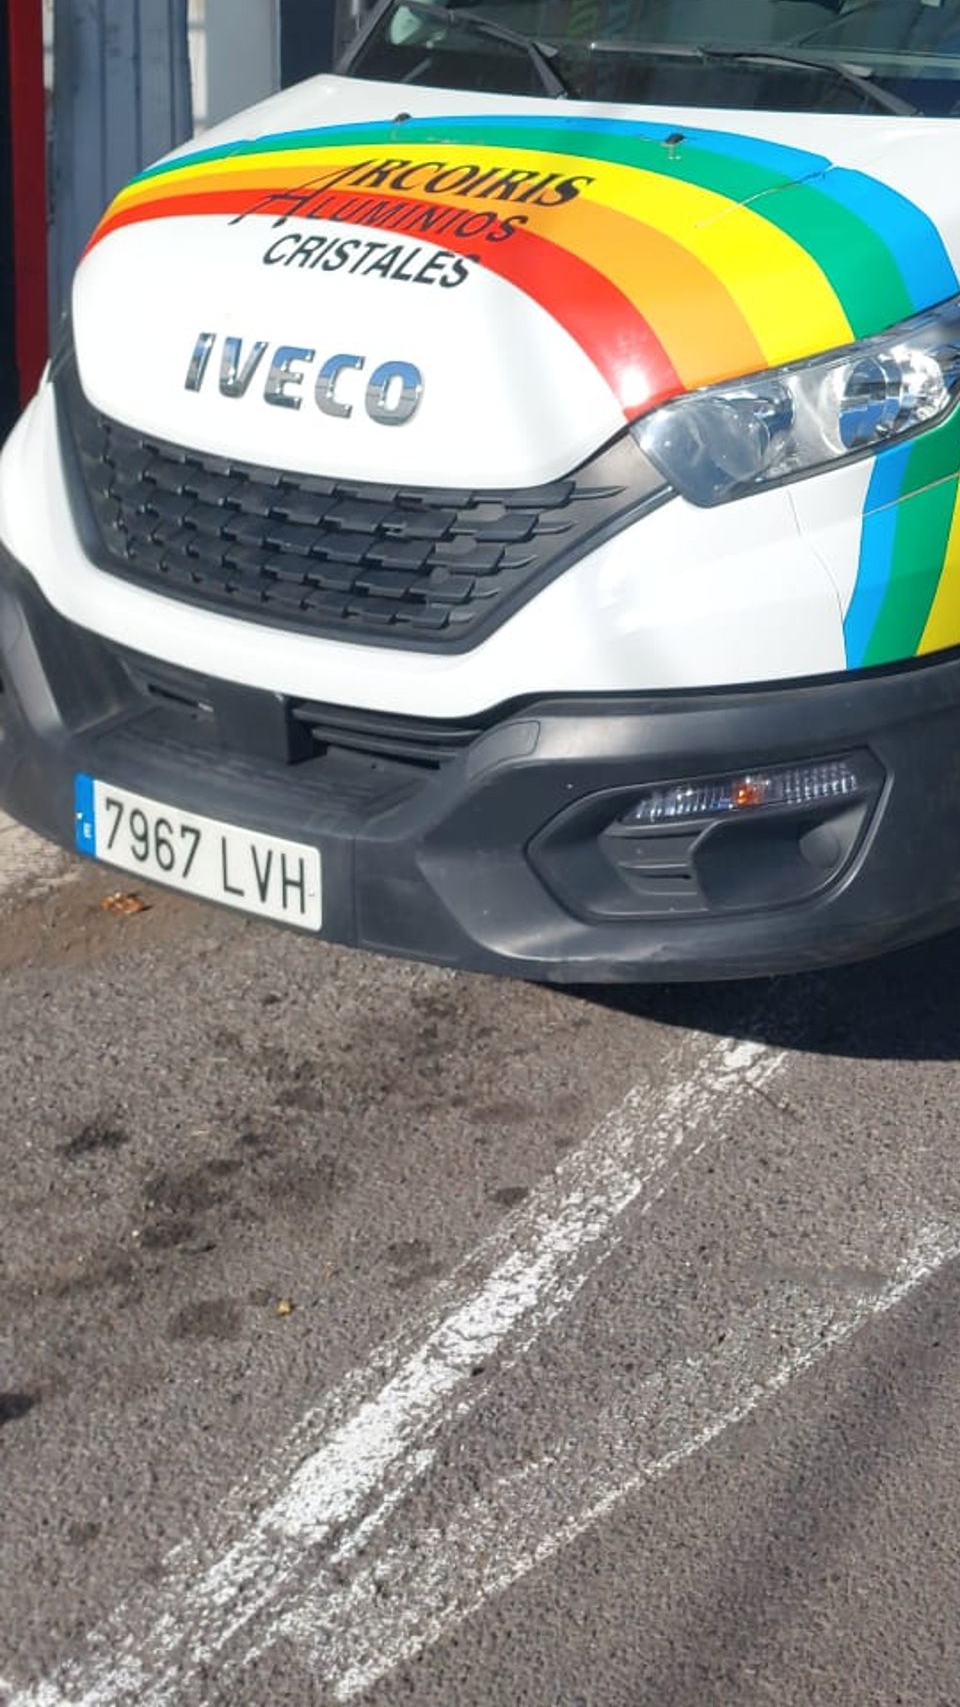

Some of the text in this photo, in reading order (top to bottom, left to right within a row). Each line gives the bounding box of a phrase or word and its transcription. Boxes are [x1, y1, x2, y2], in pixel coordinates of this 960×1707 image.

[262, 233, 480, 288] CRISTALES
[183, 331, 426, 427] IVECO
[105, 796, 306, 915] 7967 LVH
